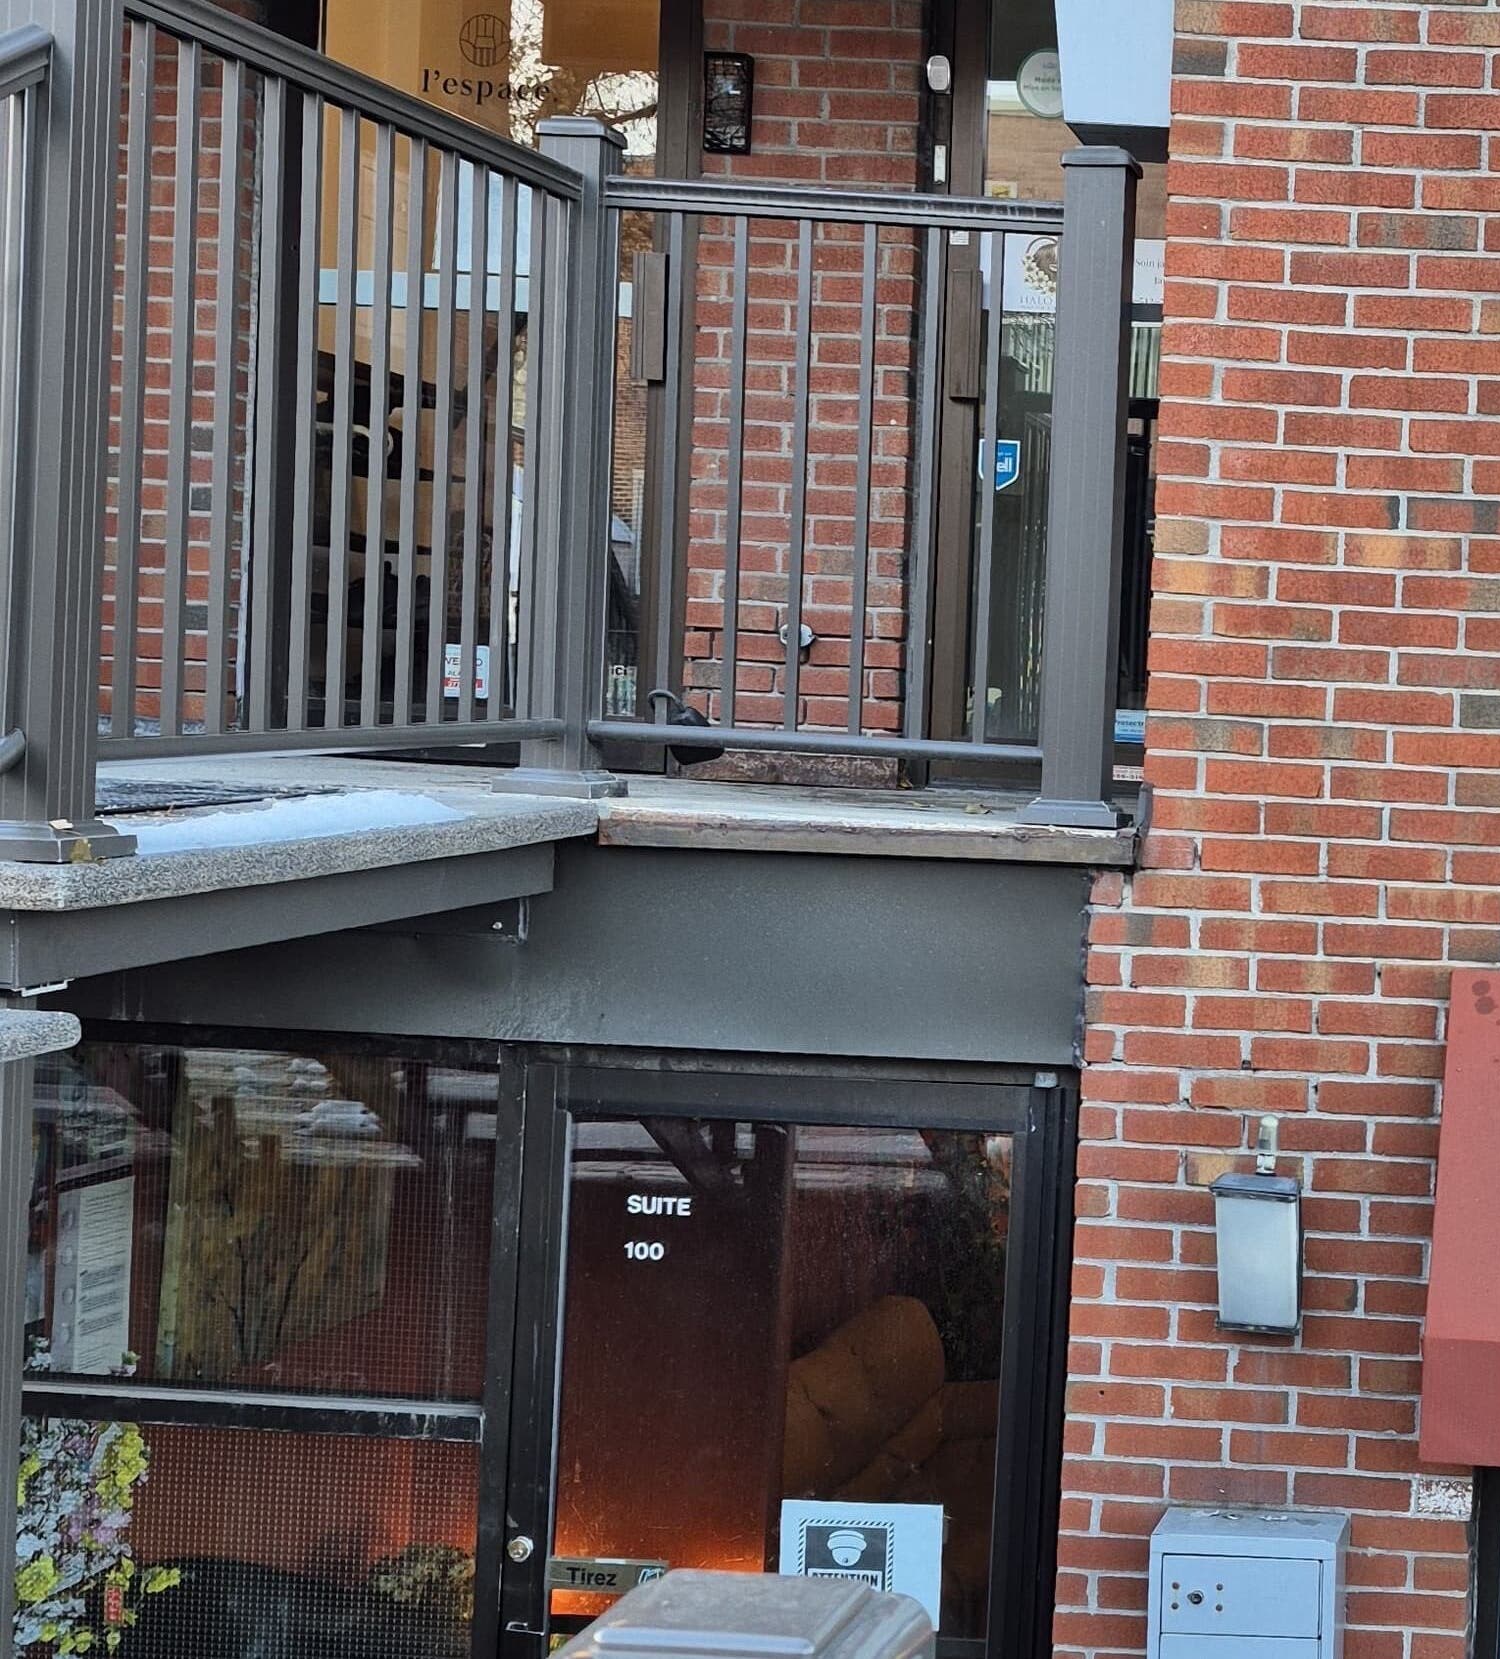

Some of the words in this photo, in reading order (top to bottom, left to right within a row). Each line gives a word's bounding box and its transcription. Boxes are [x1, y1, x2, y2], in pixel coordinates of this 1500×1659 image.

[627, 1194, 692, 1216] SUITE
[623, 1241, 665, 1261] 100
[566, 1566, 617, 1587] Tirez
